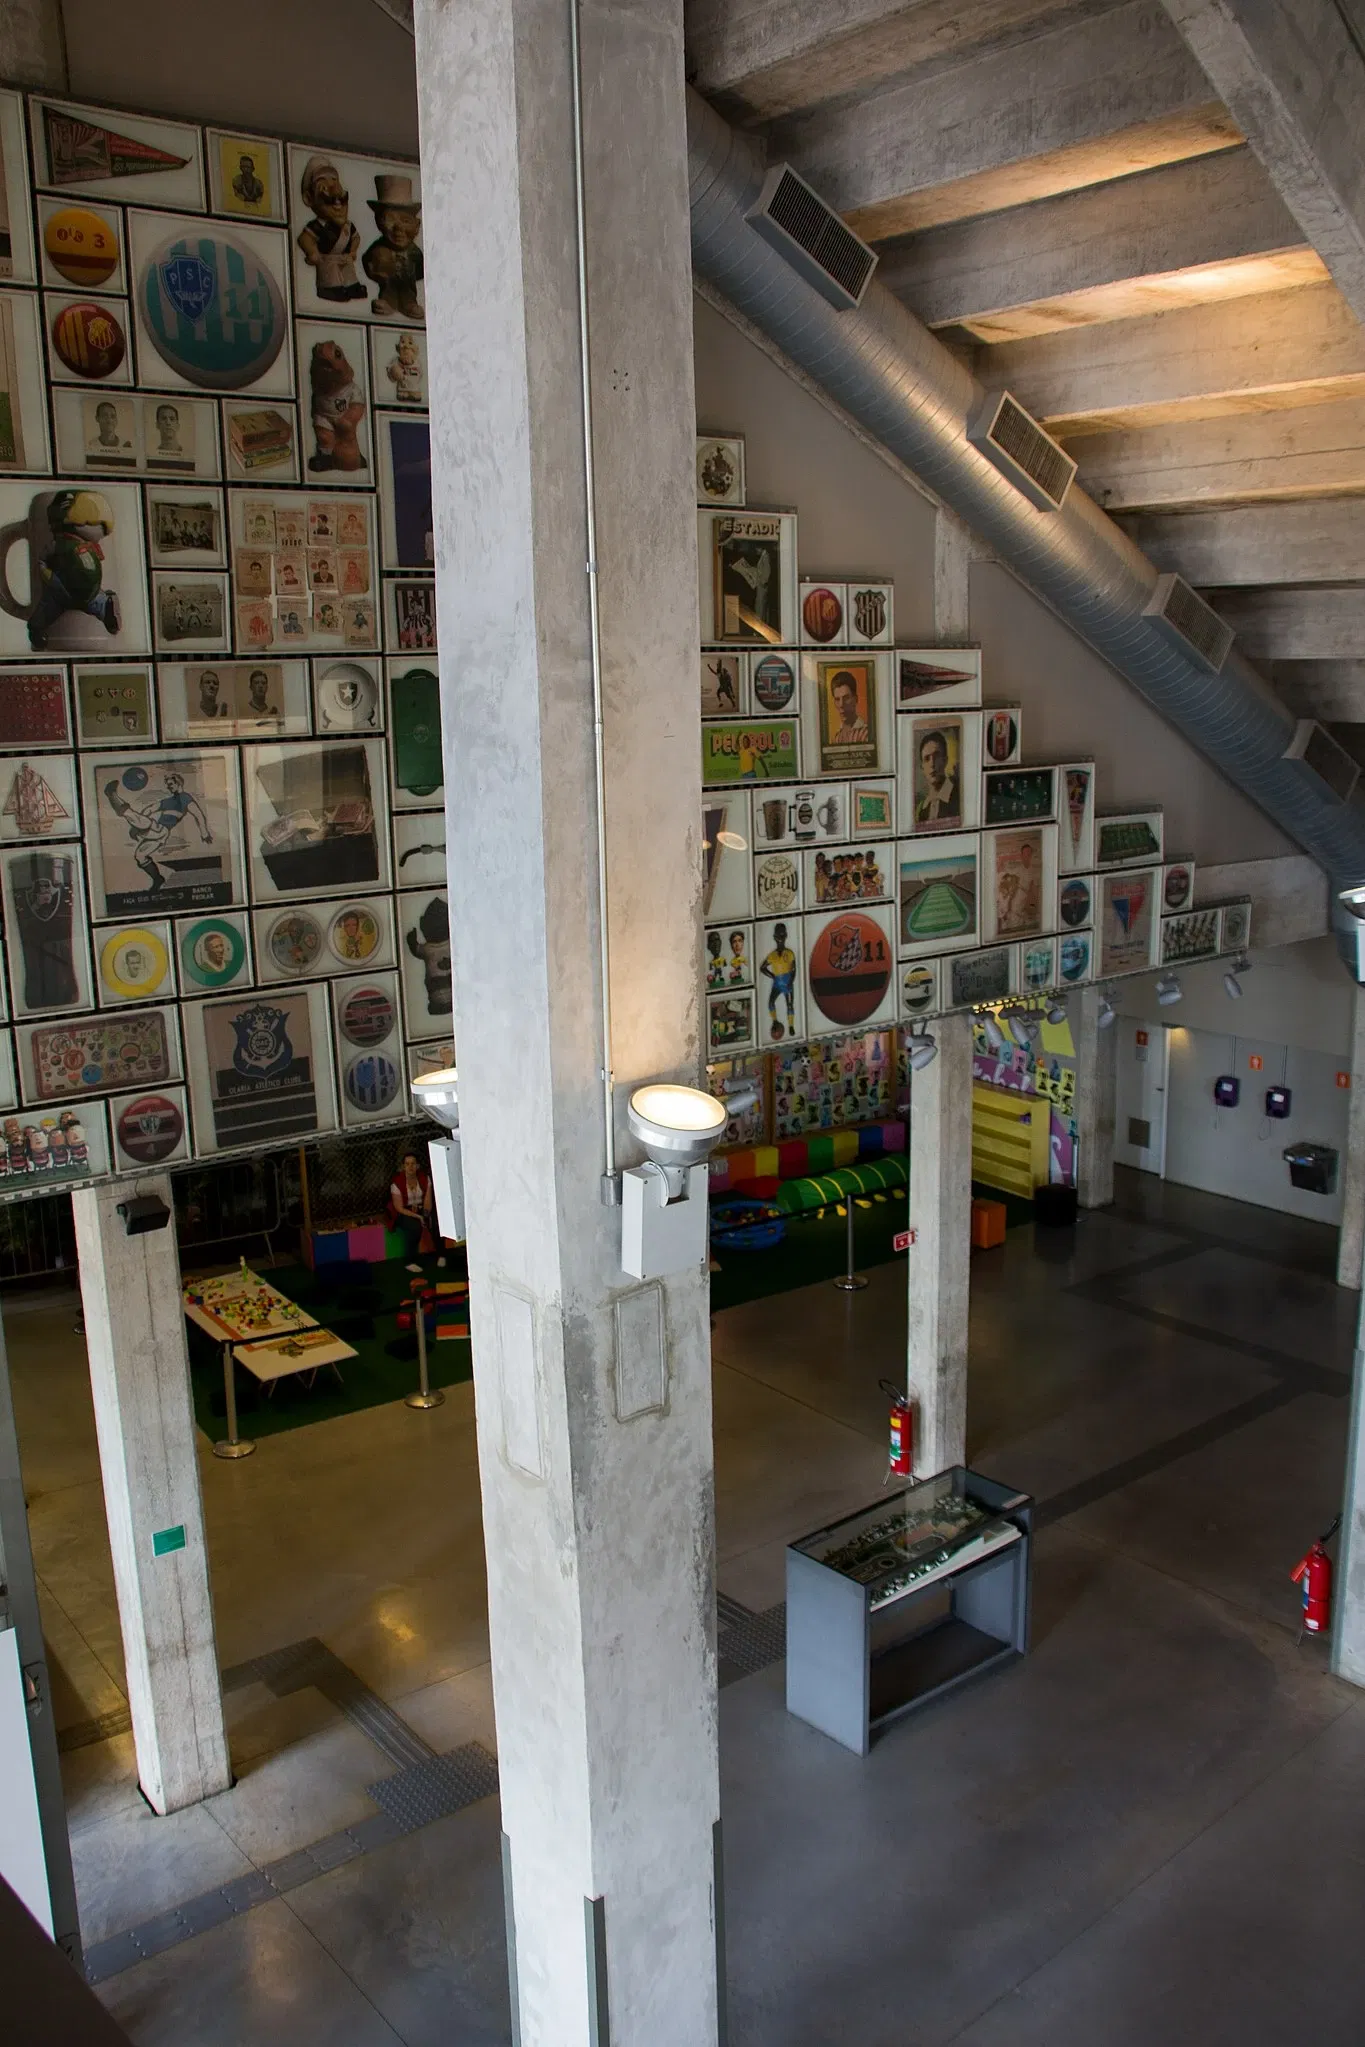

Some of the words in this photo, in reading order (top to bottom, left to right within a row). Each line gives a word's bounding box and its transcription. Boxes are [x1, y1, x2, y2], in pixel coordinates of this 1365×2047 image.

[224, 287, 265, 319] 11
[758, 871, 798, 897] FLA-FLU
[864, 940, 886, 962] 11
